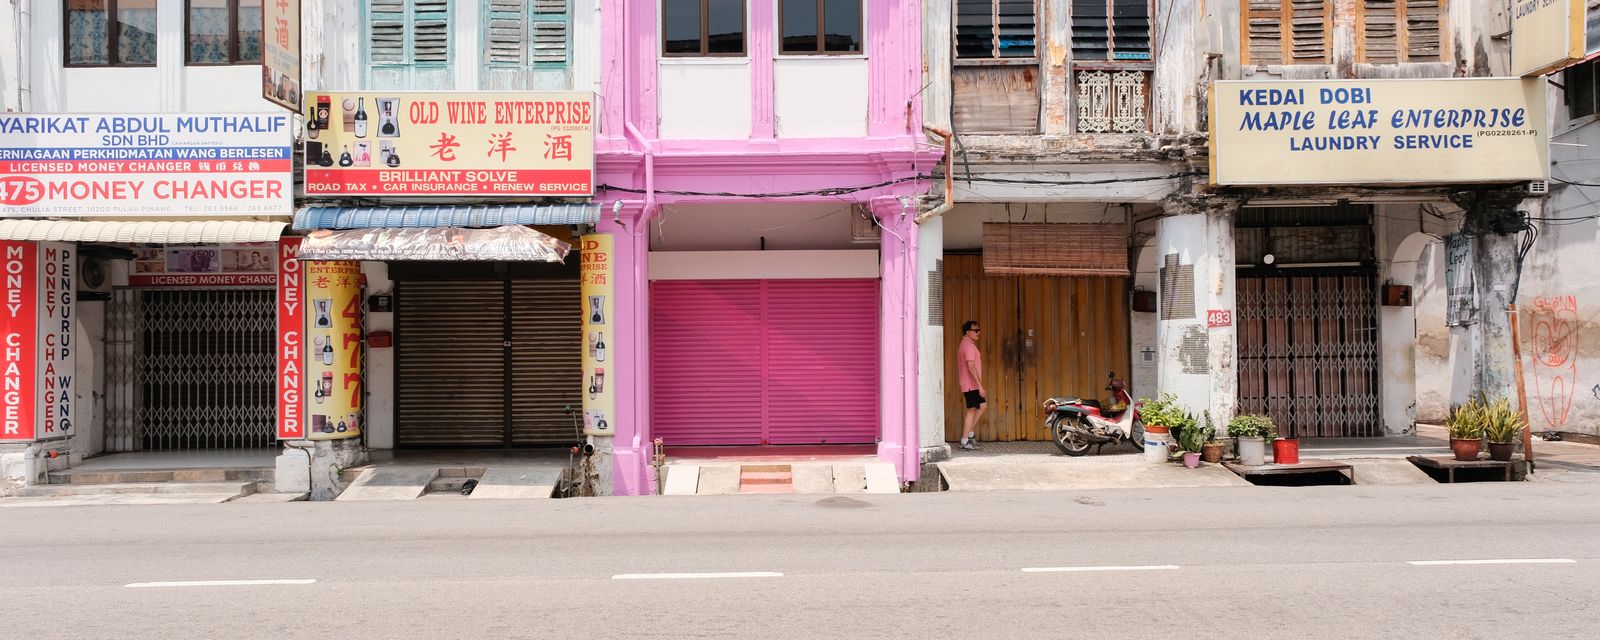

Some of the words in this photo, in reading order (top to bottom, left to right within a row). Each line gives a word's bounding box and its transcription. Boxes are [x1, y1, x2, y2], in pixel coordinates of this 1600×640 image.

[1239, 88, 1304, 106] KEDAI
[1320, 87, 1372, 104] DOBI
[410, 101, 439, 124] OLD
[447, 101, 487, 124] WINE
[495, 101, 591, 124] ENTERPRISE
[1239, 110, 1315, 131] MAPLE
[1328, 109, 1379, 130] LEAF
[1391, 107, 1526, 129] ENTERPRISE
[96, 117, 170, 133] ABDUL
[176, 116, 286, 133] MUTHALIF
[1476, 129, 1538, 138] (PG0228261-P)
[102, 135, 133, 146] SDN
[138, 135, 169, 146] BHD
[429, 131, 573, 163] 老洋酒
[1290, 135, 1381, 151] LAUNDRY
[1394, 134, 1473, 150] SERVICE
[74, 149, 172, 159] PERKHIDMATAN
[177, 149, 216, 158] WANG
[220, 148, 283, 158] BERLESEN
[10, 162, 73, 172] LICENSED
[78, 162, 124, 172] MONEY
[129, 162, 191, 171] CHANGER
[379, 171, 460, 182] BRILLIANT
[466, 171, 517, 182] SOLVE
[49, 180, 145, 200] MONEY
[153, 179, 282, 199] CHANGER
[308, 183, 341, 191] ROAD
[346, 183, 367, 191] TAX
[383, 183, 406, 191] CAR
[411, 183, 478, 191] INSURANCE
[493, 183, 534, 191] RENEW
[539, 183, 588, 191] SERVICE
[1449, 250, 1470, 265] Leaf
[6, 246, 24, 318] MONEY
[46, 248, 56, 318] MONEY
[151, 276, 197, 285] LICENSED
[200, 275, 236, 284] MONEY
[238, 275, 276, 284] CHANG
[283, 244, 299, 316] MONEY
[61, 250, 70, 361] PENGURUP
[1208, 312, 1231, 324] 483
[341, 294, 360, 408] 477
[5, 332, 21, 435] CHANGER
[44, 333, 55, 432] CHANGER
[283, 331, 299, 433] CHANGER
